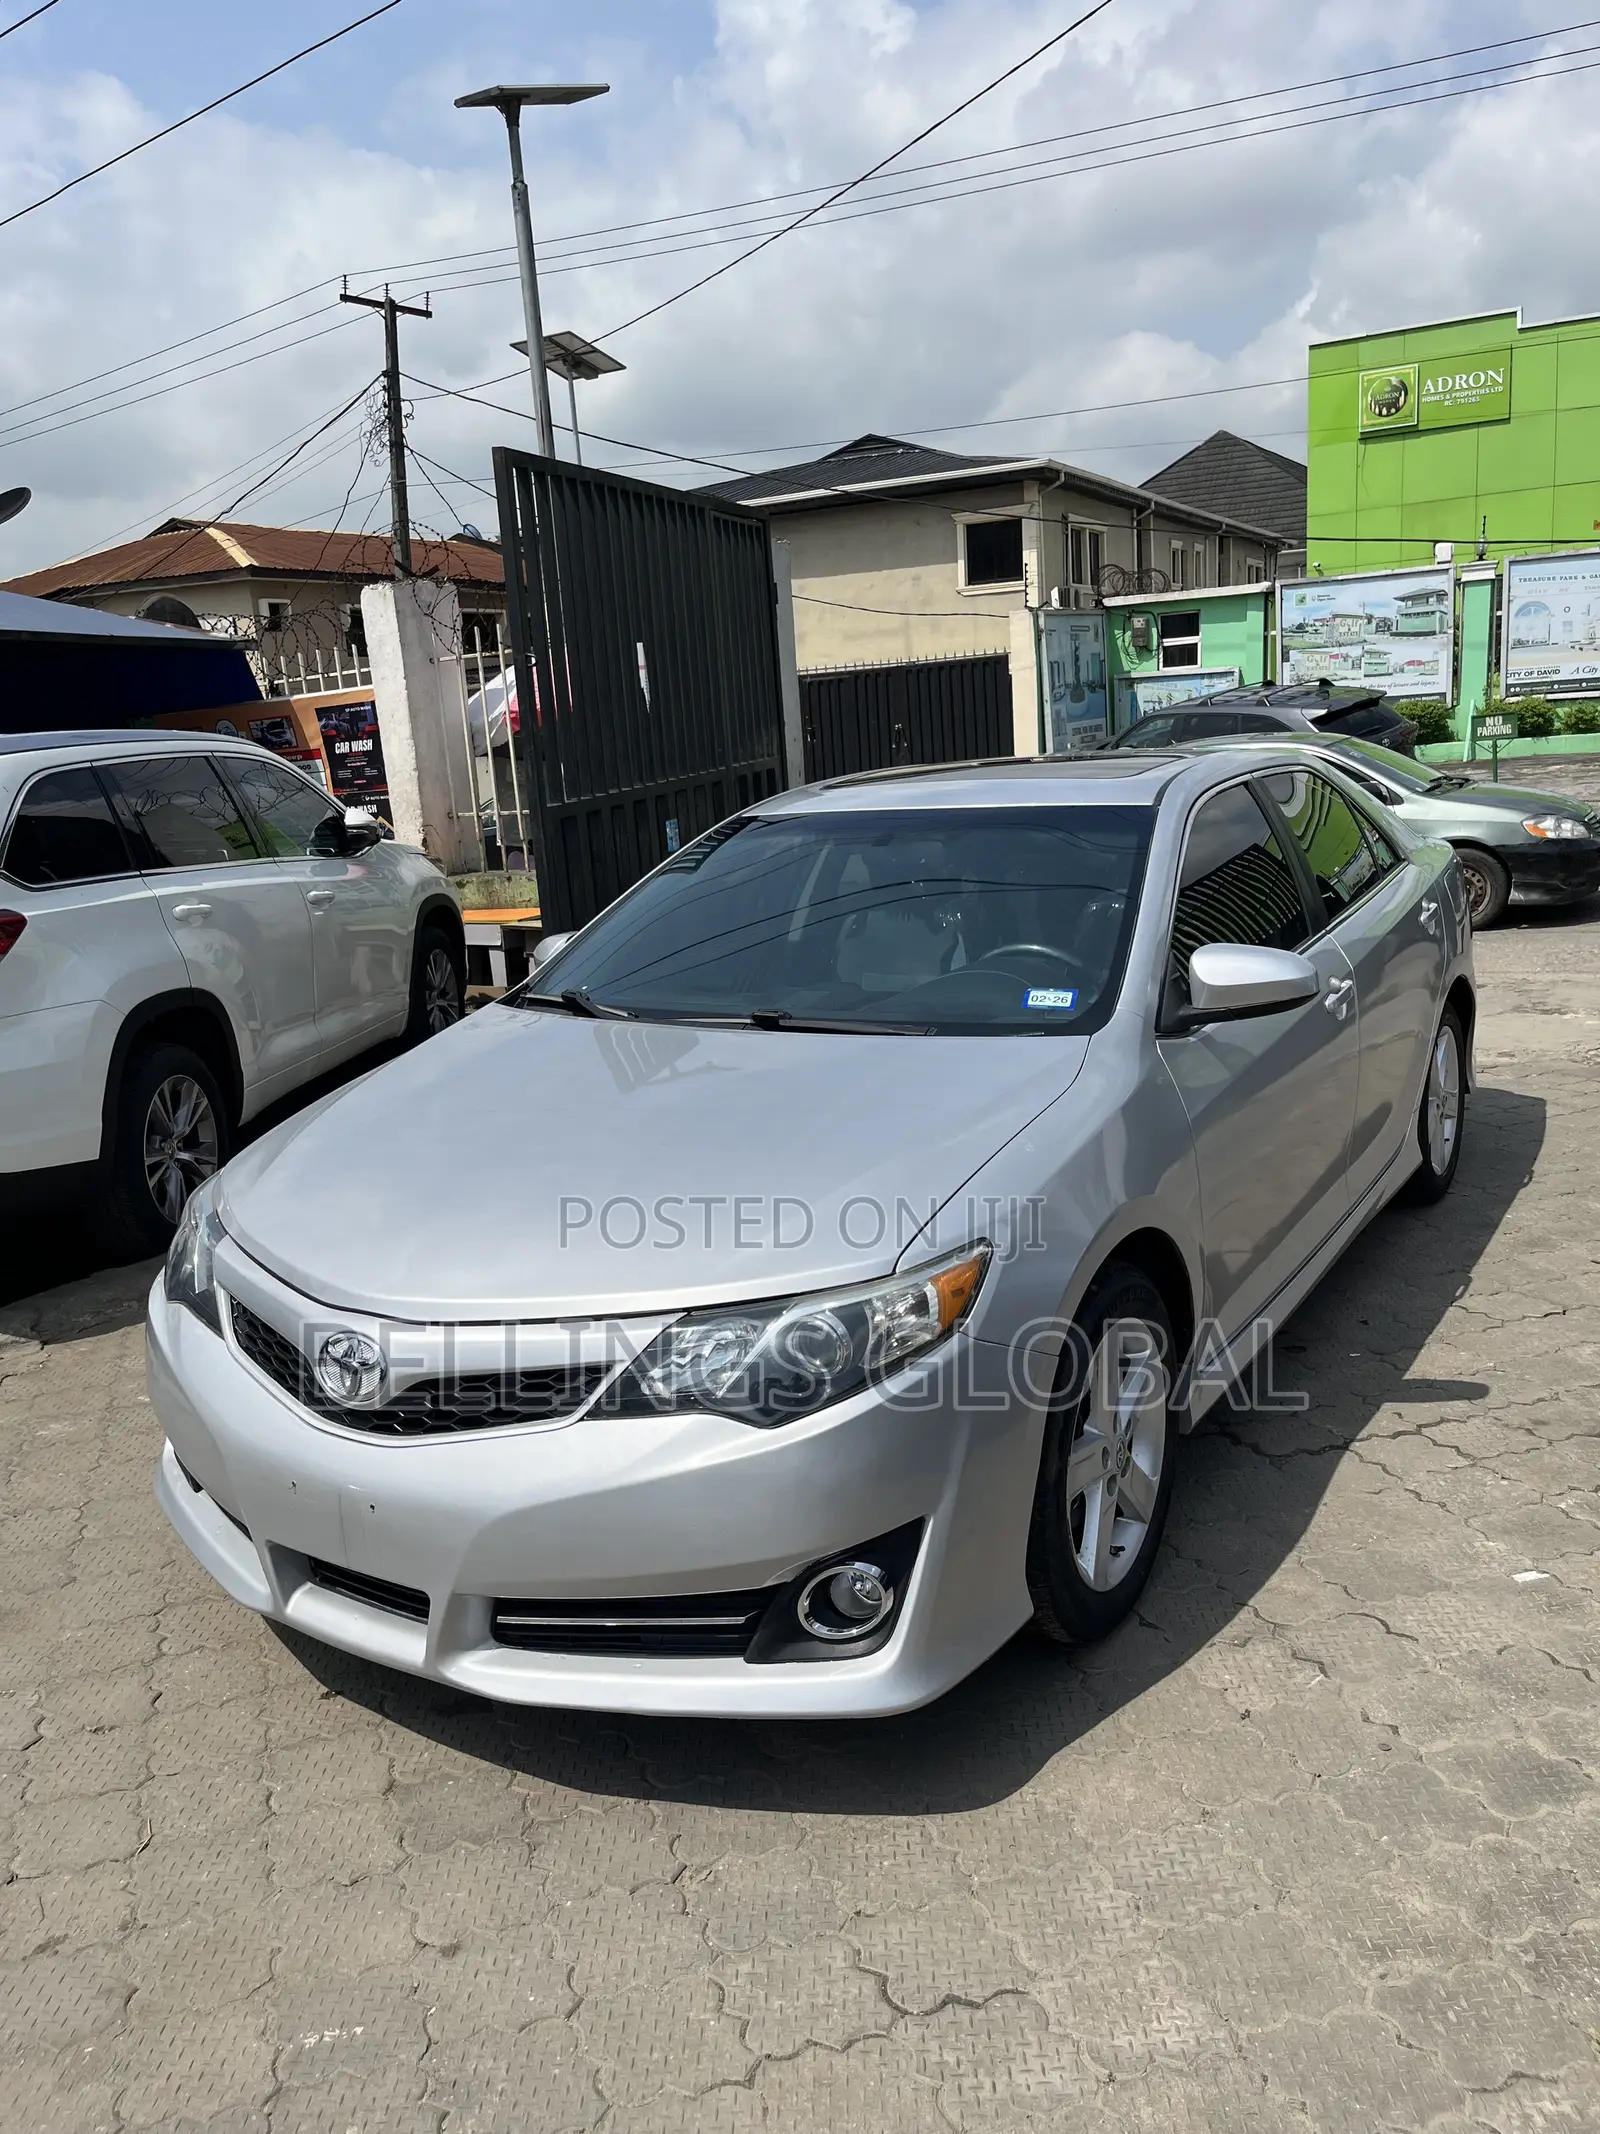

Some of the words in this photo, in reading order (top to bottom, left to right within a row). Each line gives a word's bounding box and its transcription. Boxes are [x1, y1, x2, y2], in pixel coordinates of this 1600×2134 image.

[1422, 368, 1505, 395] ADRON
[1422, 395, 1444, 404] HOMES
[1451, 387, 1490, 399] PROPERTIES
[1518, 575, 1557, 583] TREASURE
[1524, 669, 1535, 677] OF
[1537, 668, 1560, 676] DAVID
[1570, 666, 1579, 674] A
[1582, 665, 1598, 676] City
[1485, 715, 1503, 726] NO
[1477, 724, 1512, 737] PARKING
[335, 741, 349, 754] CAR
[351, 739, 372, 752] WASH
